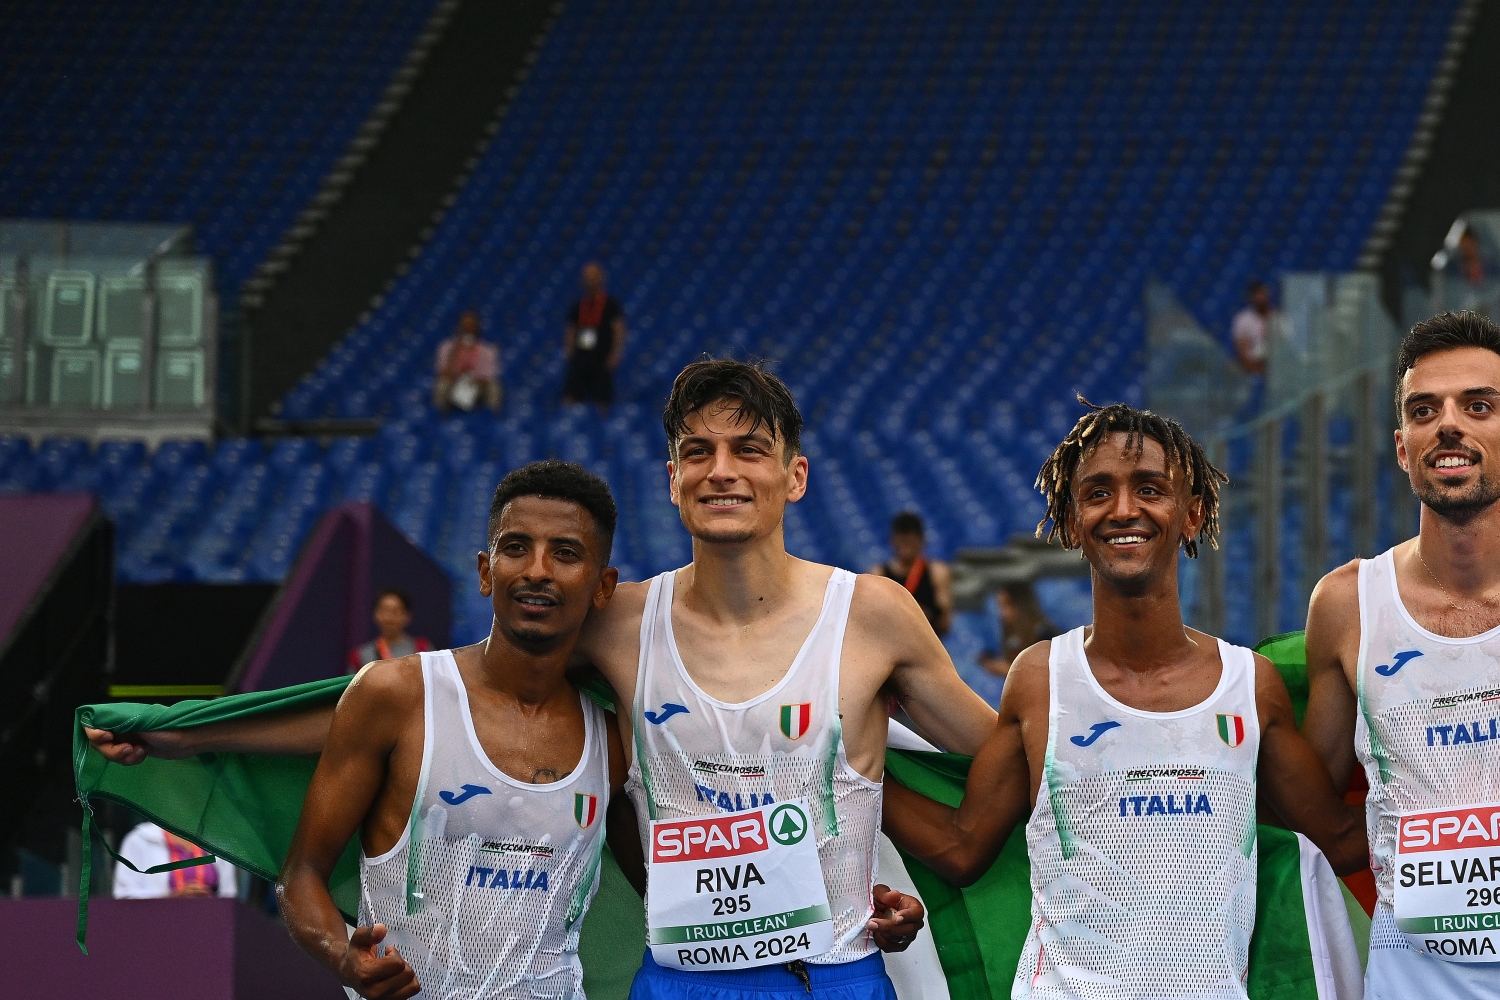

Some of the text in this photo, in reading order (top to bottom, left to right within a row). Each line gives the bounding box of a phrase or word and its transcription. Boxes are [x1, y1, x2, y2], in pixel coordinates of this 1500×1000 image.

[693, 760, 766, 774] FRECCIAROSSA
[1126, 768, 1205, 778] FRECCIAROSSA
[694, 783, 775, 812] ITALIA
[1118, 793, 1213, 817] ITALIA
[481, 841, 554, 855] FRECCIAROSSA
[657, 818, 764, 857] SPAR
[466, 865, 548, 892] ITALIA
[695, 862, 766, 893] RIVA
[711, 894, 751, 916] 295
[685, 928, 690, 941] I
[693, 925, 729, 940] RUN
[1434, 919, 1439, 931] I
[1442, 916, 1479, 930] RUN
[677, 932, 811, 966] ROMA 2024
[1424, 937, 1497, 956] ROMA
